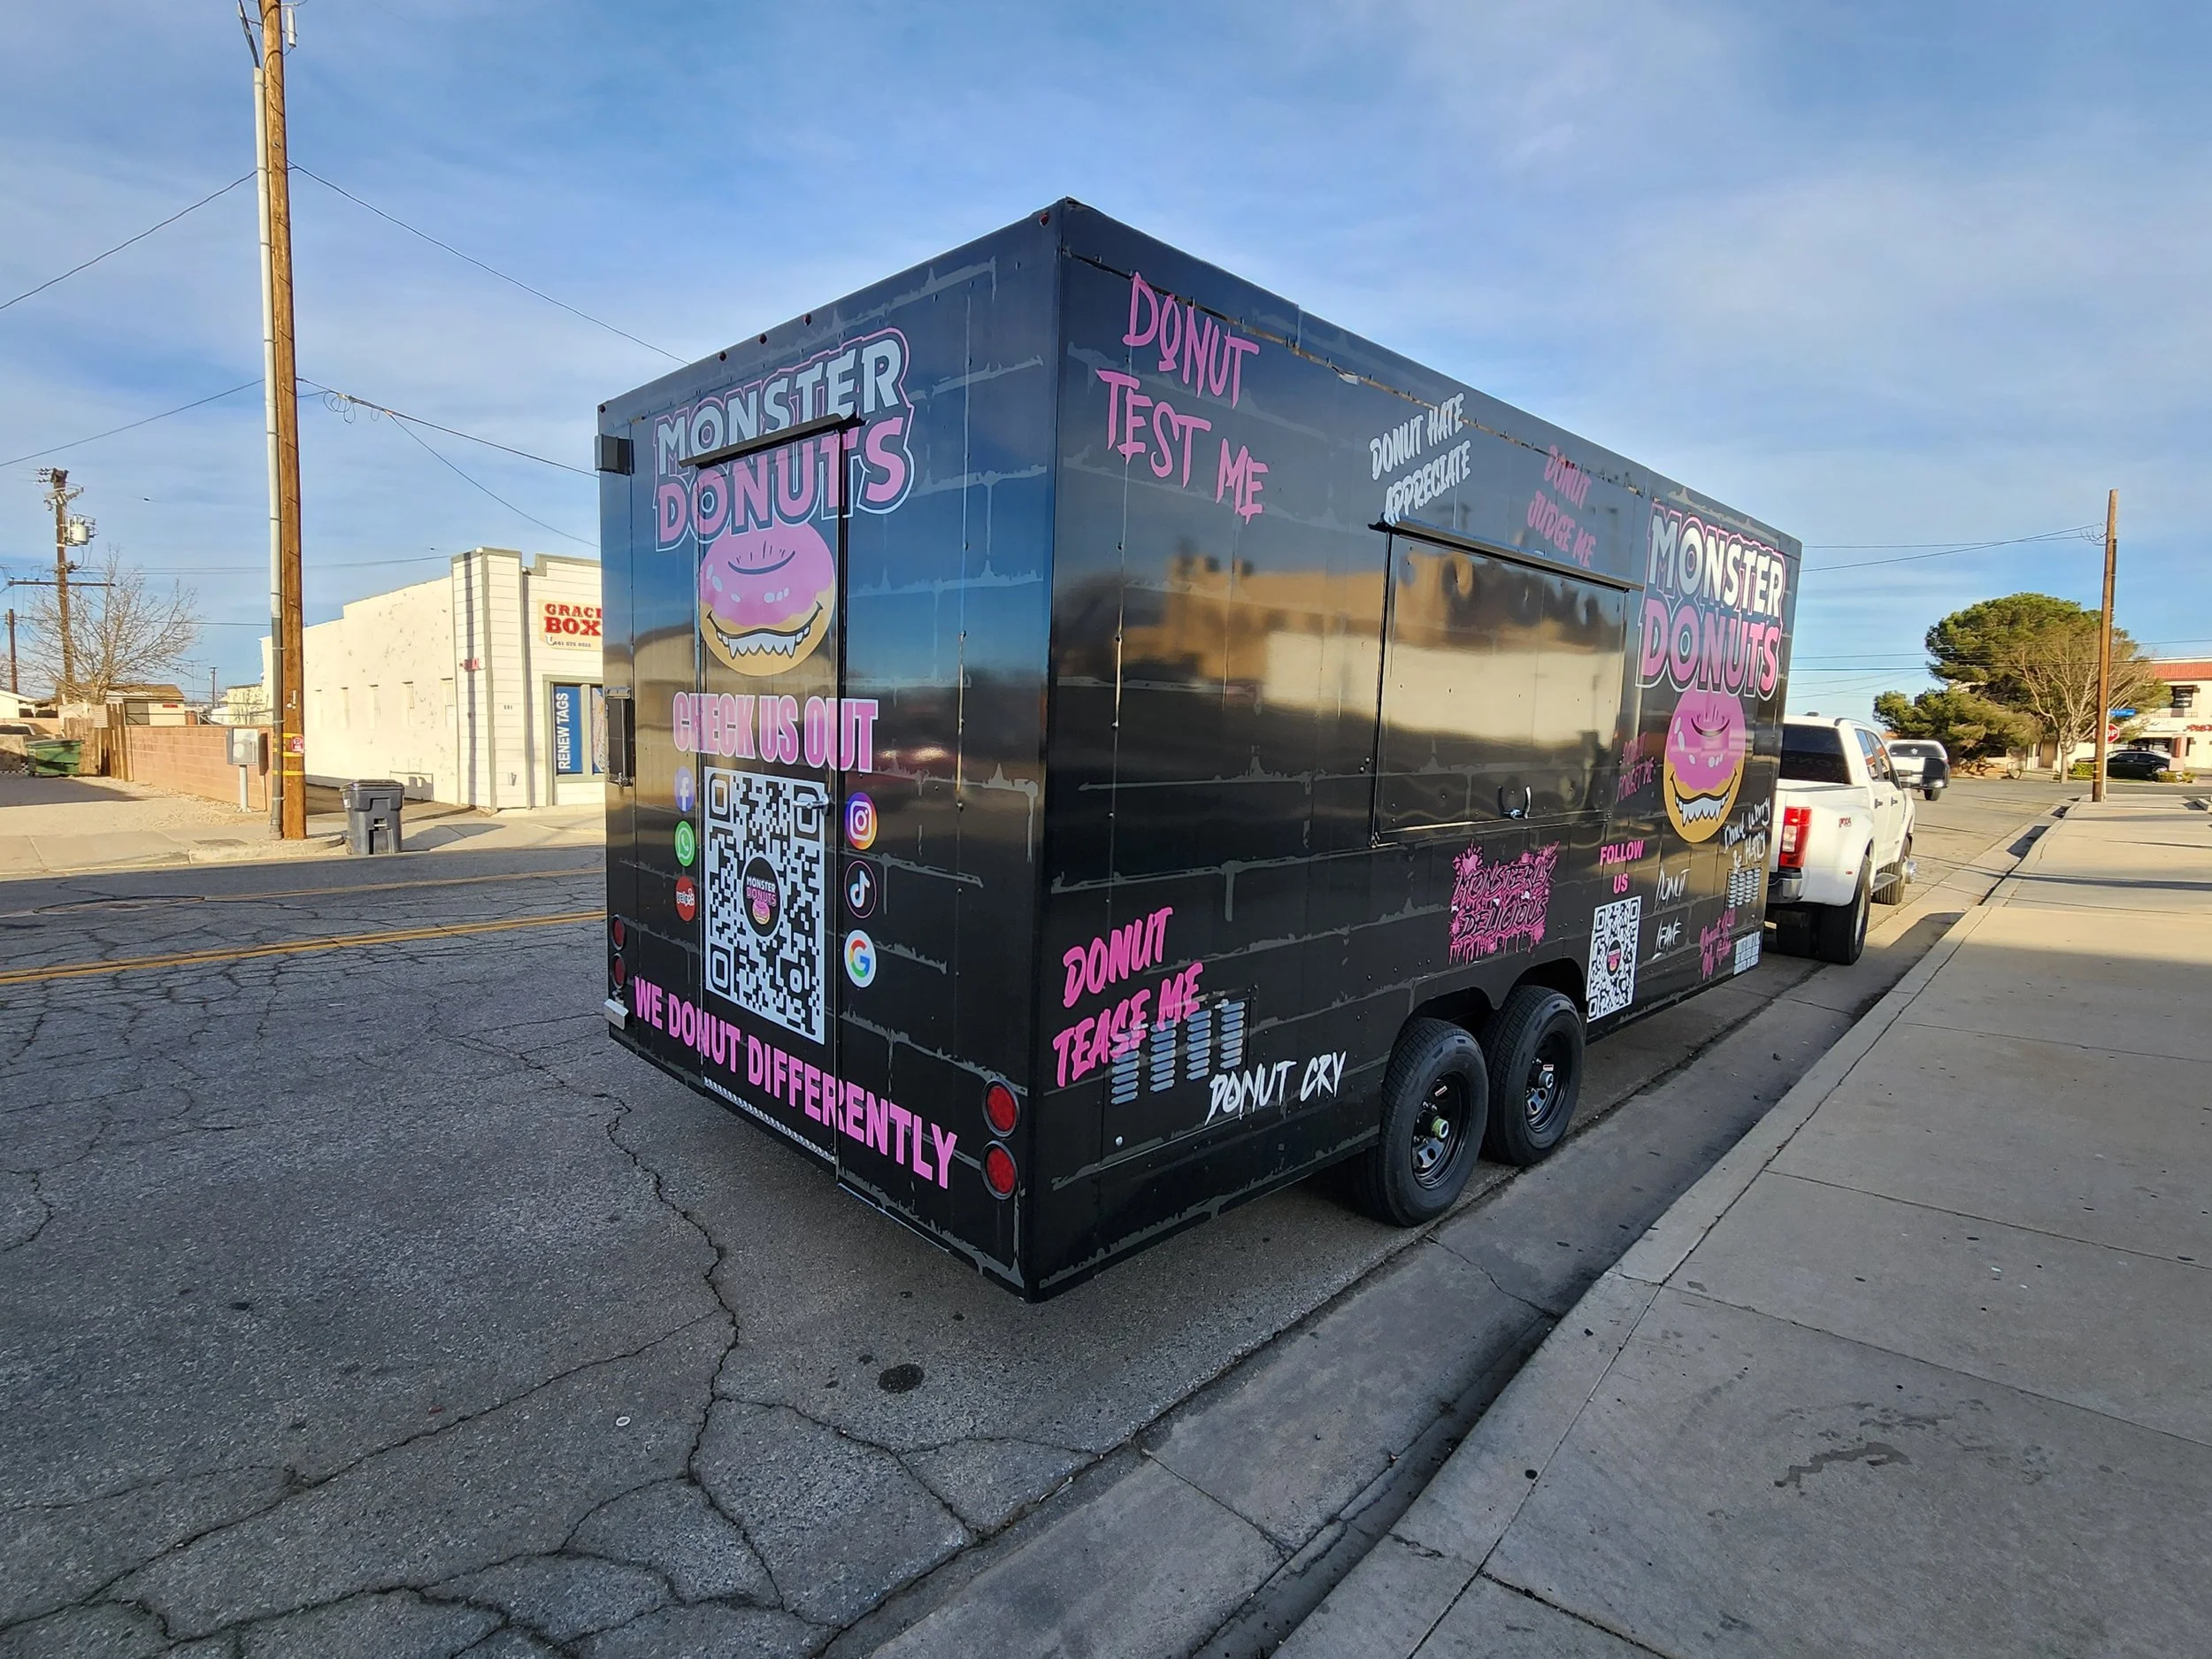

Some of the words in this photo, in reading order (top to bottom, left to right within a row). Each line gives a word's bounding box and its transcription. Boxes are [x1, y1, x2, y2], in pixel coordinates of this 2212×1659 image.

[1122, 271, 1260, 410] DONUT
[657, 339, 902, 476] MONSTER
[1094, 368, 1212, 488] TEST
[1217, 438, 1269, 526] ME
[1370, 414, 1424, 480] DONUT
[1427, 393, 1464, 447] HATE
[657, 417, 906, 543] DONUTS
[1384, 440, 1471, 526] APPRECIATE
[1544, 444, 1592, 511] DONUT
[1572, 526, 1596, 568] ME
[1648, 515, 1784, 617] MONSTER
[543, 616, 601, 636] BOX
[1642, 598, 1779, 692] DONUTS
[556, 692, 570, 723] TAGS
[557, 726, 571, 770] RENEW
[672, 691, 757, 760] CHECK
[759, 695, 799, 765] US
[803, 695, 879, 773] OUT
[746, 876, 776, 894] MONSTER
[1599, 840, 1644, 866] FOLLOW
[1613, 872, 1629, 895] US
[746, 887, 777, 907] DONUTS
[1455, 896, 1549, 941] DELICIOUS
[1063, 906, 1173, 1009] DONUT
[1052, 988, 1151, 1087] TEASE
[1157, 962, 1203, 1032] ME
[634, 976, 664, 1030] WE
[668, 993, 741, 1073] DONUT
[748, 1033, 958, 1190] DIFFERENTLY
[1204, 1061, 1297, 1126] DONUT
[1300, 1050, 1347, 1102] CRY
